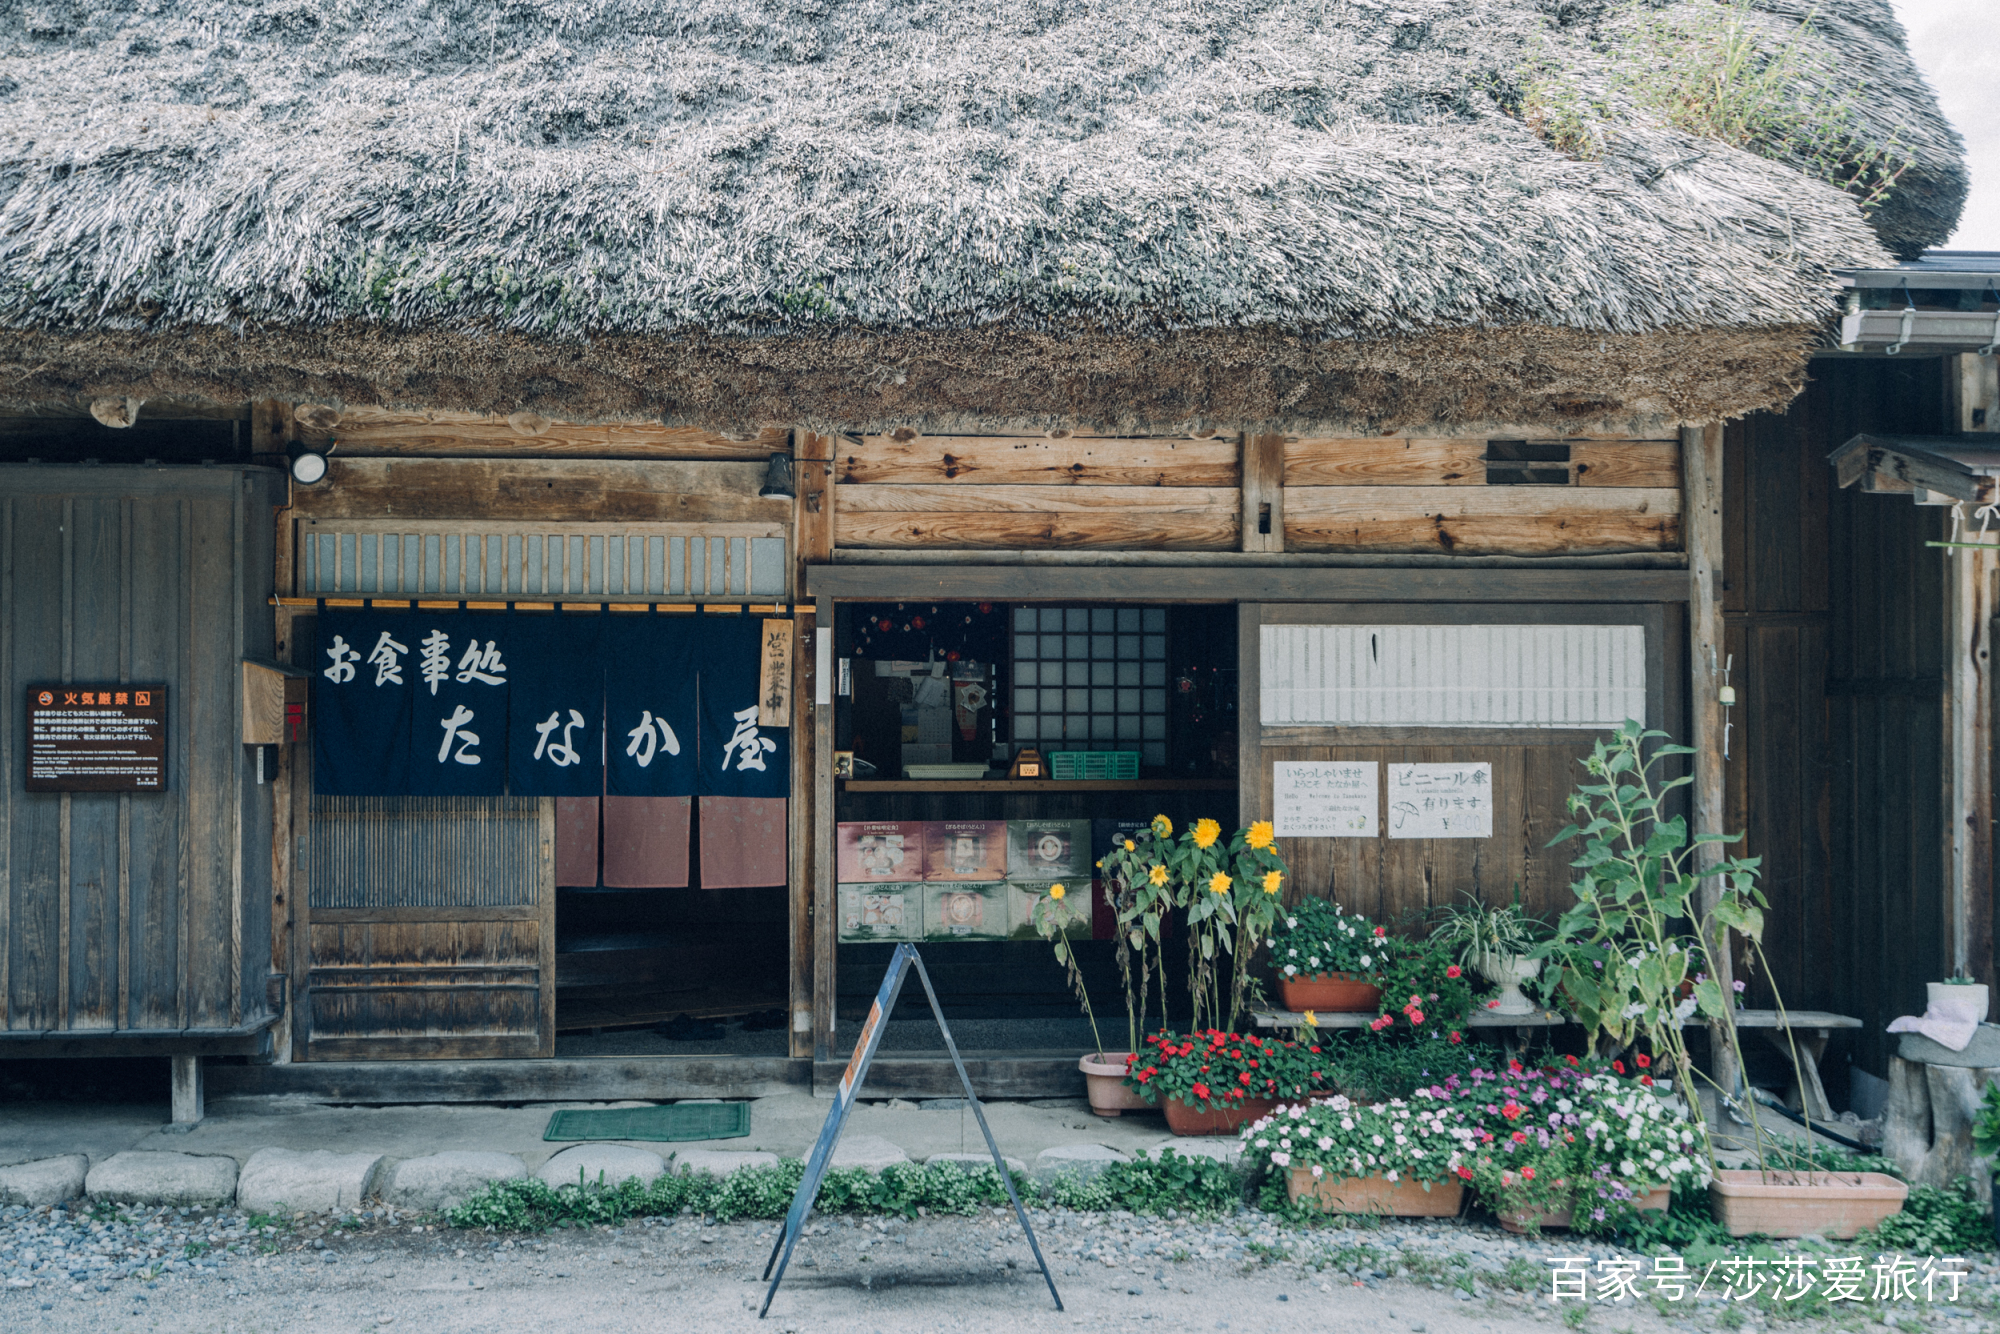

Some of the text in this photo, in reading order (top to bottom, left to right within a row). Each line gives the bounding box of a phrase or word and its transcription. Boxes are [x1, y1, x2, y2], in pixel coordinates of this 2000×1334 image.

[323, 629, 508, 696] お食事処
[766, 631, 788, 718] 営業中
[64, 691, 129, 706] 火気厳禁
[437, 704, 777, 772] たなか屋
[1286, 768, 1363, 779] いらっしゃいませ
[1398, 769, 1488, 787] ビニール傘
[1292, 780, 1321, 789] ようこそ
